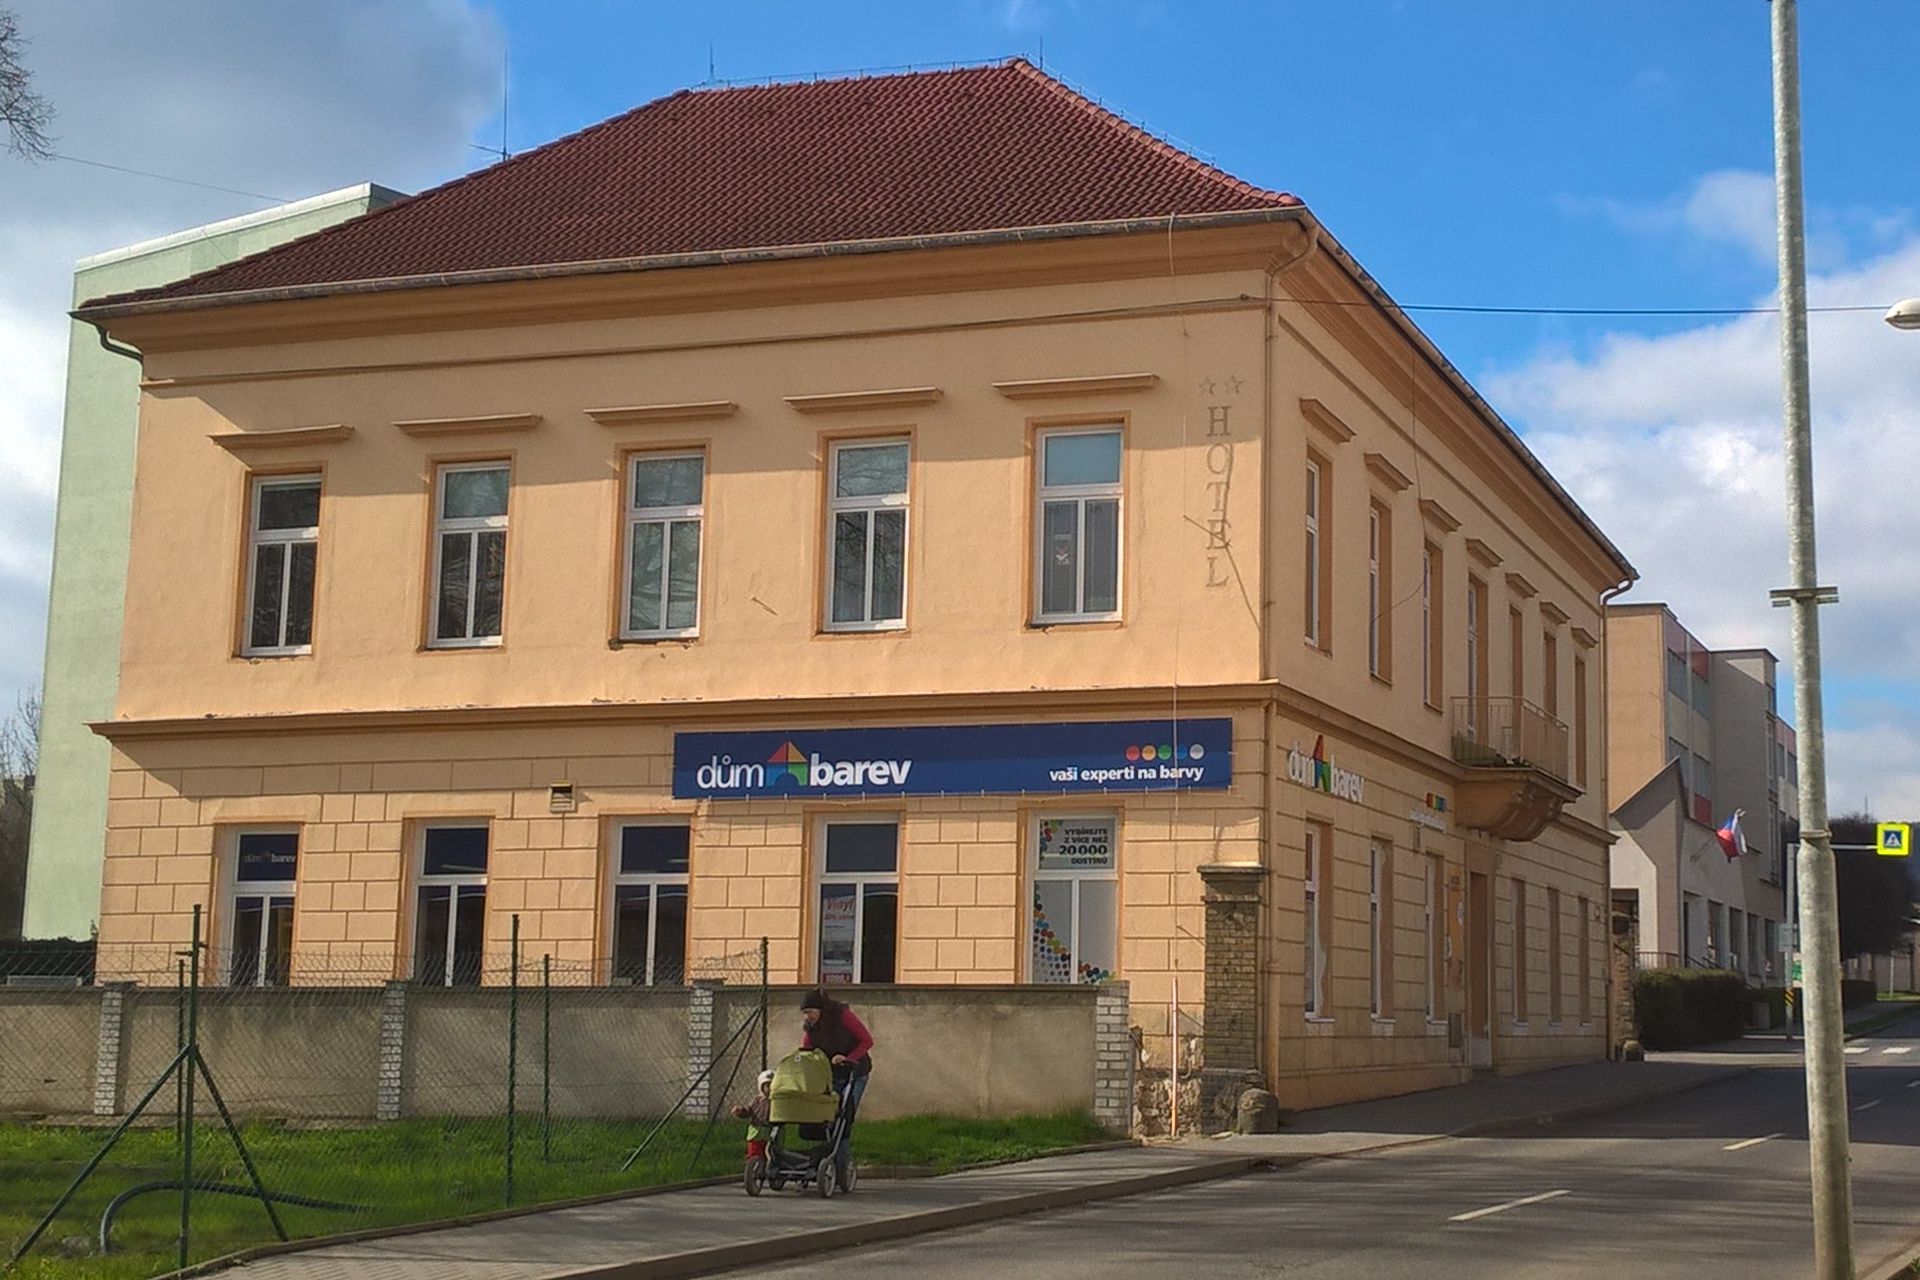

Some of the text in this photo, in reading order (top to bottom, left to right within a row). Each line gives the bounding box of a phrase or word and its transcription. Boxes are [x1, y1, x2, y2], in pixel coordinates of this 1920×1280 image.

[1206, 405, 1232, 588] HOTEL
[696, 752, 912, 789] dům barev
[1049, 764, 1204, 784] vaši experti na barvy
[1330, 753, 1365, 803] barev
